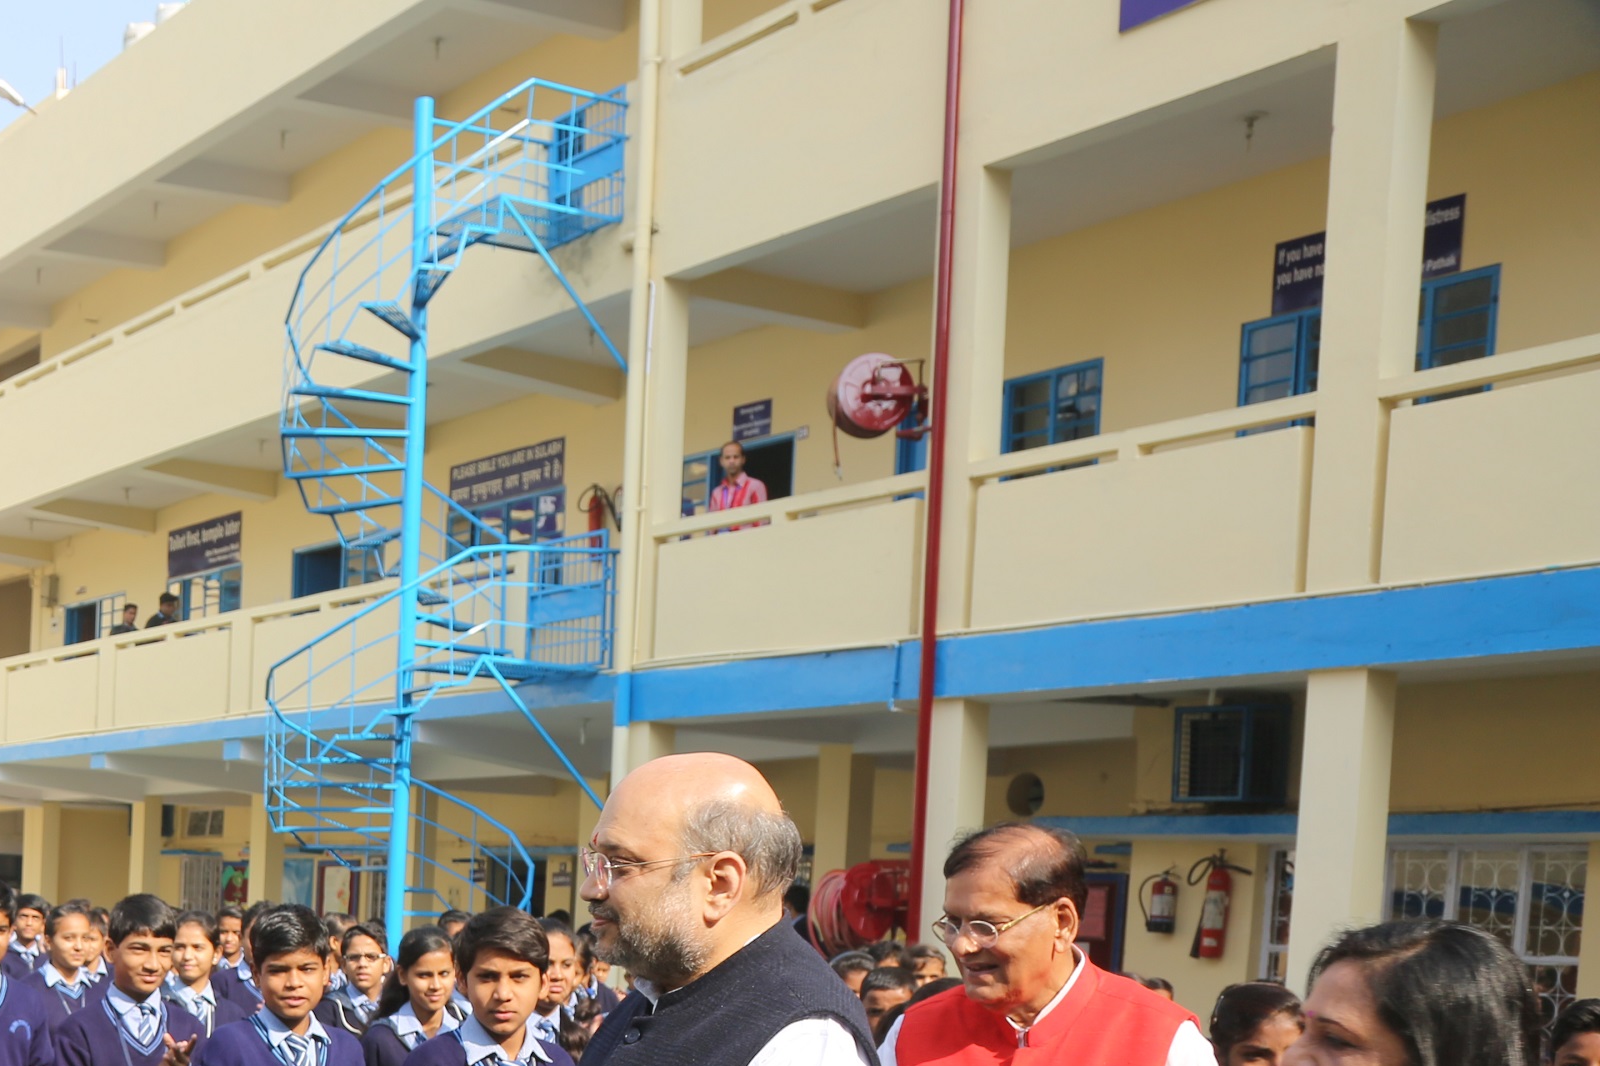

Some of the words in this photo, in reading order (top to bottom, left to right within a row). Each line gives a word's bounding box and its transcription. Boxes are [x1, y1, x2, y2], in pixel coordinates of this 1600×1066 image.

[1278, 248, 1286, 265] If
[1286, 249, 1301, 267] you
[1303, 243, 1323, 259] have
[1277, 272, 1292, 290] you
[1293, 267, 1313, 282] have
[452, 462, 476, 480] PLEASE
[478, 457, 496, 474] SMILE
[497, 454, 511, 469] YOU
[512, 449, 526, 465] ARE
[534, 440, 563, 459] SULABH
